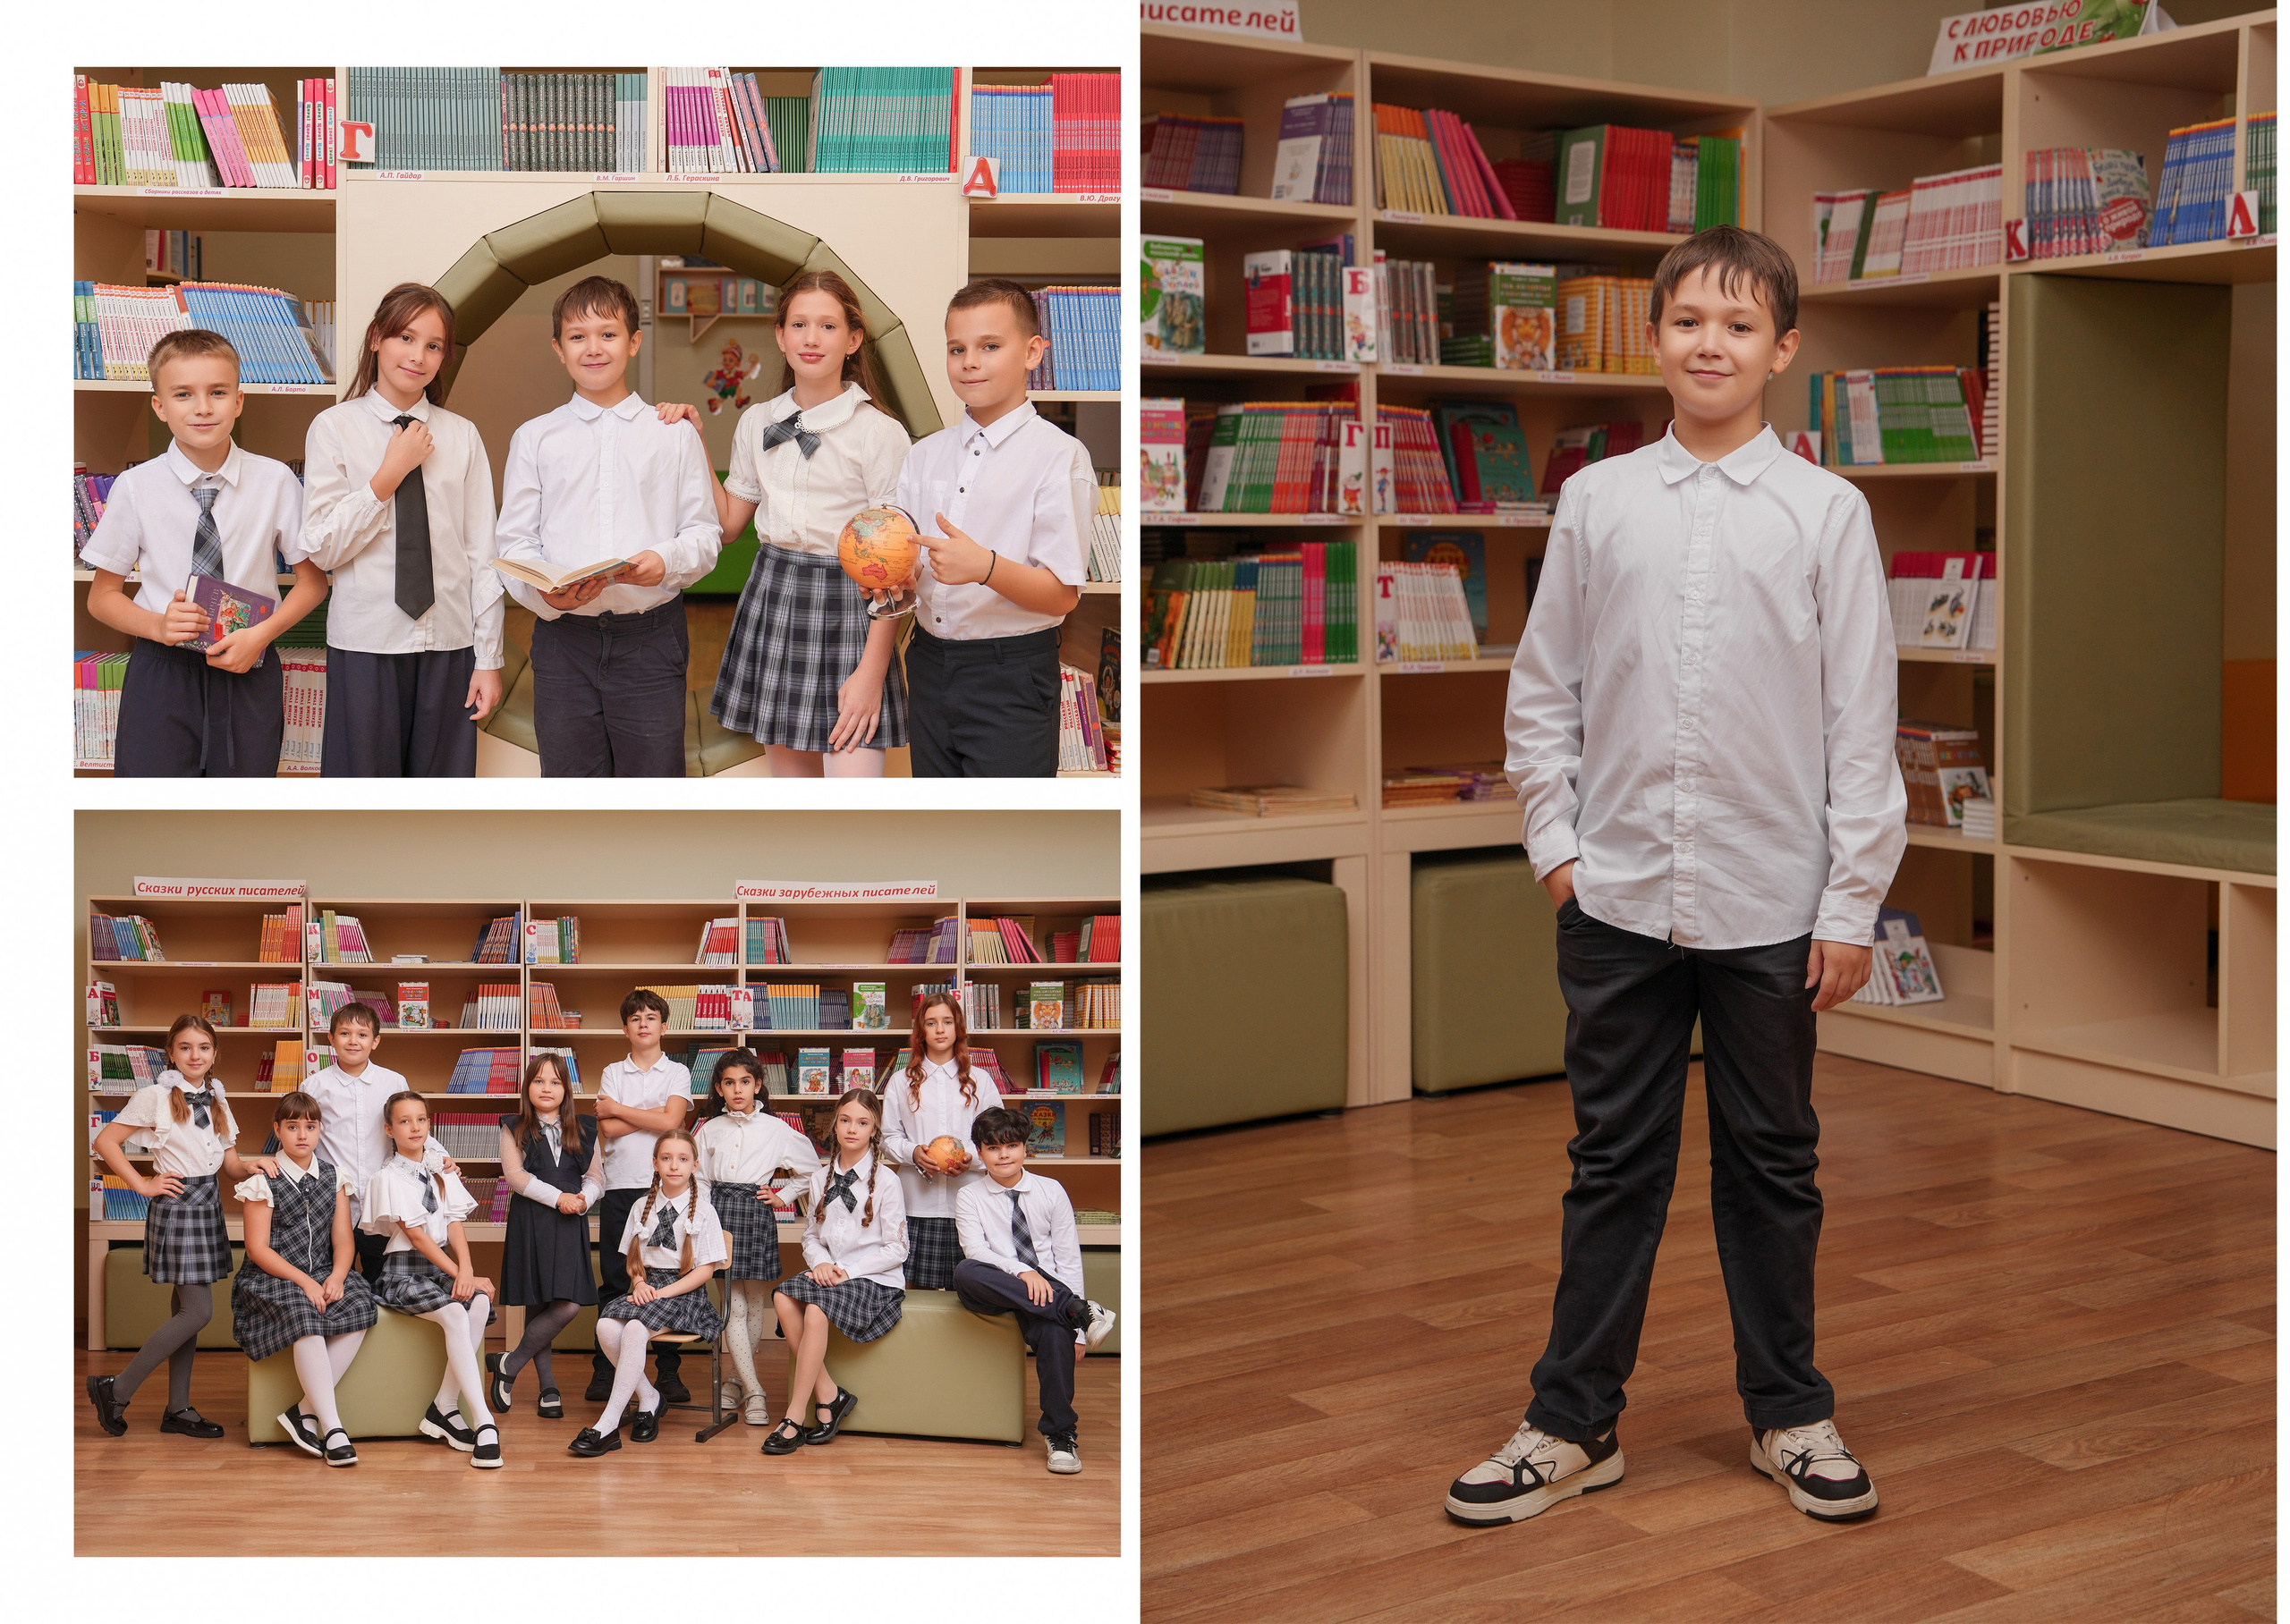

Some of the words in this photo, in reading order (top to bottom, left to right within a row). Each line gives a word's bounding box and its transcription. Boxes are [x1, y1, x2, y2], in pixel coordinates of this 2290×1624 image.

[1948, 20, 1961, 39] С
[1963, 0, 2083, 38] ЛЮБОВЬЮ
[1953, 42, 1972, 63] К
[1974, 21, 2096, 61] ПРИРОДЕ
[339, 121, 374, 159] Г
[395, 172, 422, 181] Гайдар
[611, 174, 636, 182] Гаршин
[683, 174, 720, 182] Гераскина
[913, 175, 950, 183] Григорович
[963, 156, 997, 197] А
[2227, 193, 2256, 236] Л
[2005, 219, 2026, 259] К
[1347, 271, 1370, 294] Б
[285, 385, 306, 393] Барто
[1346, 424, 1363, 447] Г
[1375, 426, 1390, 449] П
[1377, 576, 1394, 598] Т
[137, 882, 182, 894] Сказки
[186, 884, 235, 897] русских
[238, 884, 306, 896] писателей
[736, 885, 776, 897] Сказки
[778, 887, 860, 900] зарубежных
[862, 884, 936, 898] писателей
[308, 925, 319, 935] К
[526, 925, 537, 935] С
[87, 987, 99, 999] А
[309, 989, 320, 1000] М
[732, 990, 742, 1001] Т
[743, 991, 752, 1002] А
[952, 990, 962, 1001] Б
[89, 1051, 99, 1062] Б
[307, 1052, 318, 1063] О
[90, 1117, 100, 1128] Г
